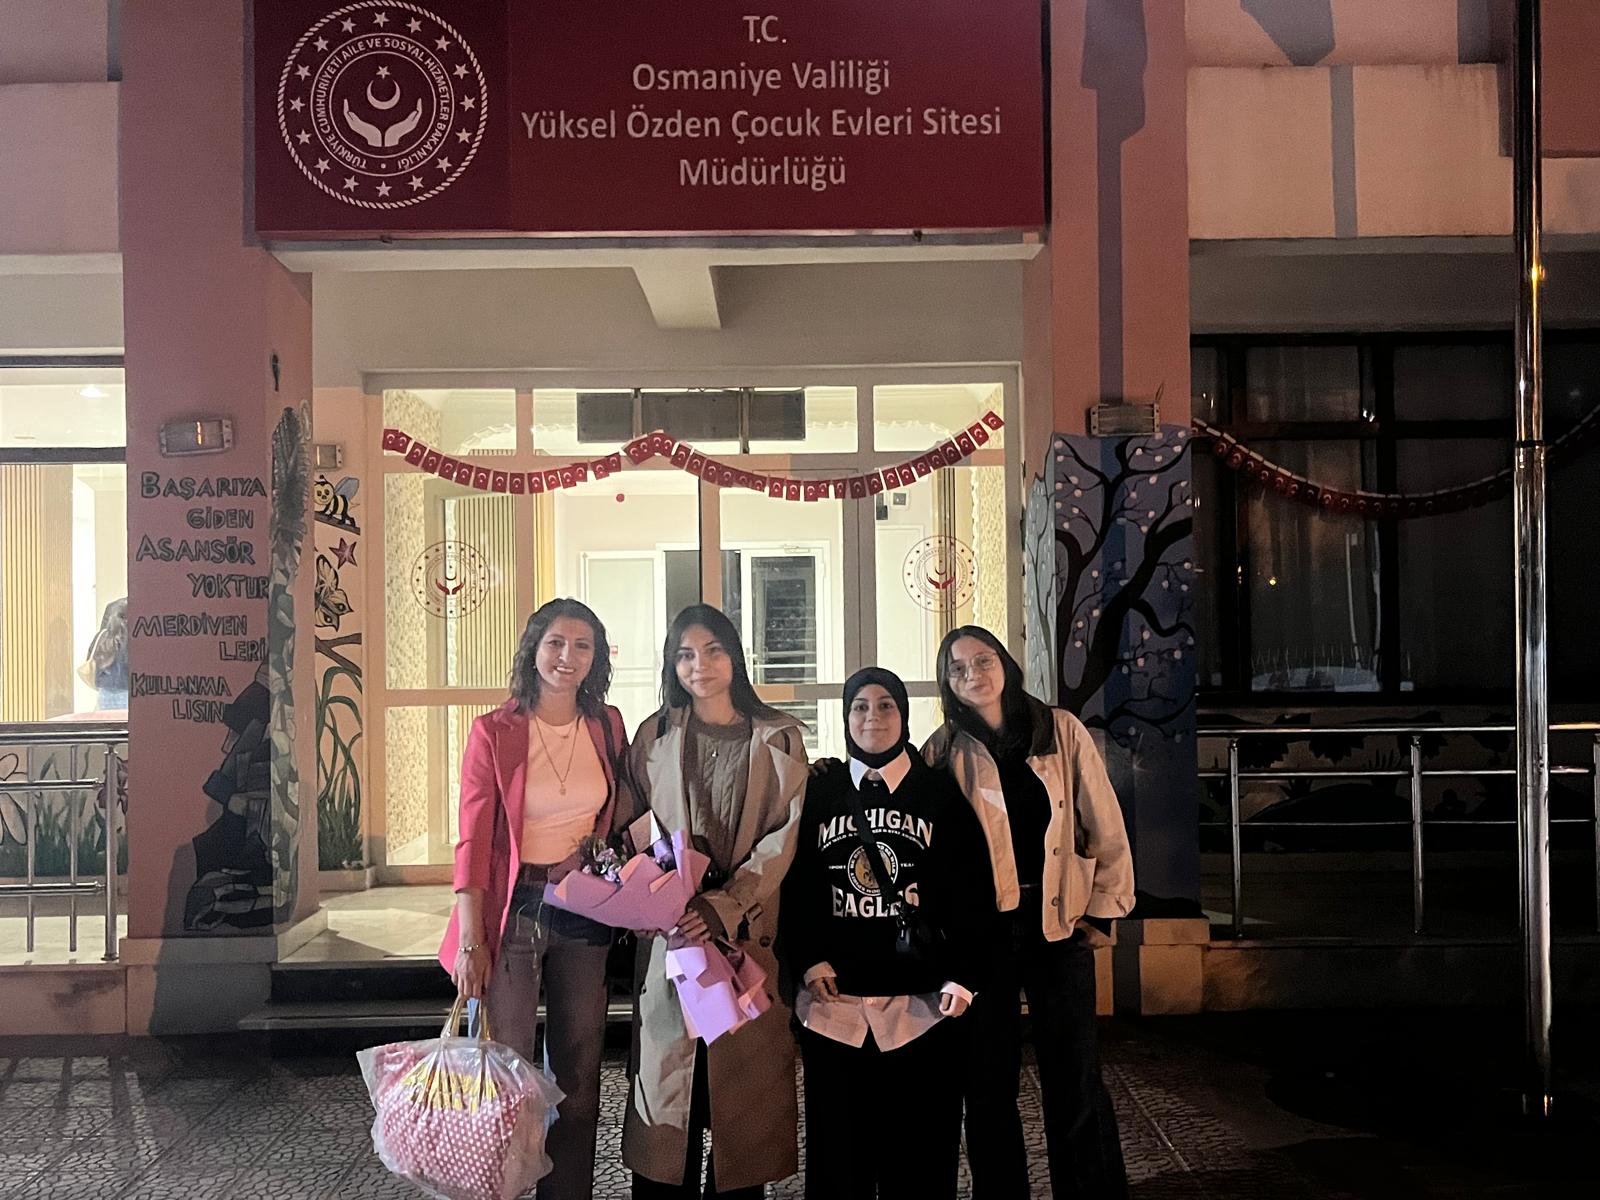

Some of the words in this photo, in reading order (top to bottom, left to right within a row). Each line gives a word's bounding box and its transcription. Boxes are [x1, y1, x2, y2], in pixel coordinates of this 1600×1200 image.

[742, 15, 787, 43] T.C.
[366, 38, 381, 48] VE
[384, 38, 424, 62] SOSYAL
[632, 61, 782, 96] Osmaniye
[792, 60, 890, 95] Valiliği
[521, 110, 617, 140] Yüksel
[626, 105, 721, 139] Özden
[731, 109, 821, 144] Çocuk
[832, 107, 912, 136] Evleri
[923, 106, 1002, 136] Sitesi
[679, 156, 847, 191] Müdürlüğü
[141, 471, 268, 501] BAŞARIYA
[186, 506, 254, 530] GİDEN
[136, 534, 256, 565] ASANSÖR
[186, 572, 270, 599] YOKTUR
[132, 611, 248, 638] MERDİVEN
[130, 672, 233, 698] KULLANMA
[818, 808, 933, 849] MICHIGAN
